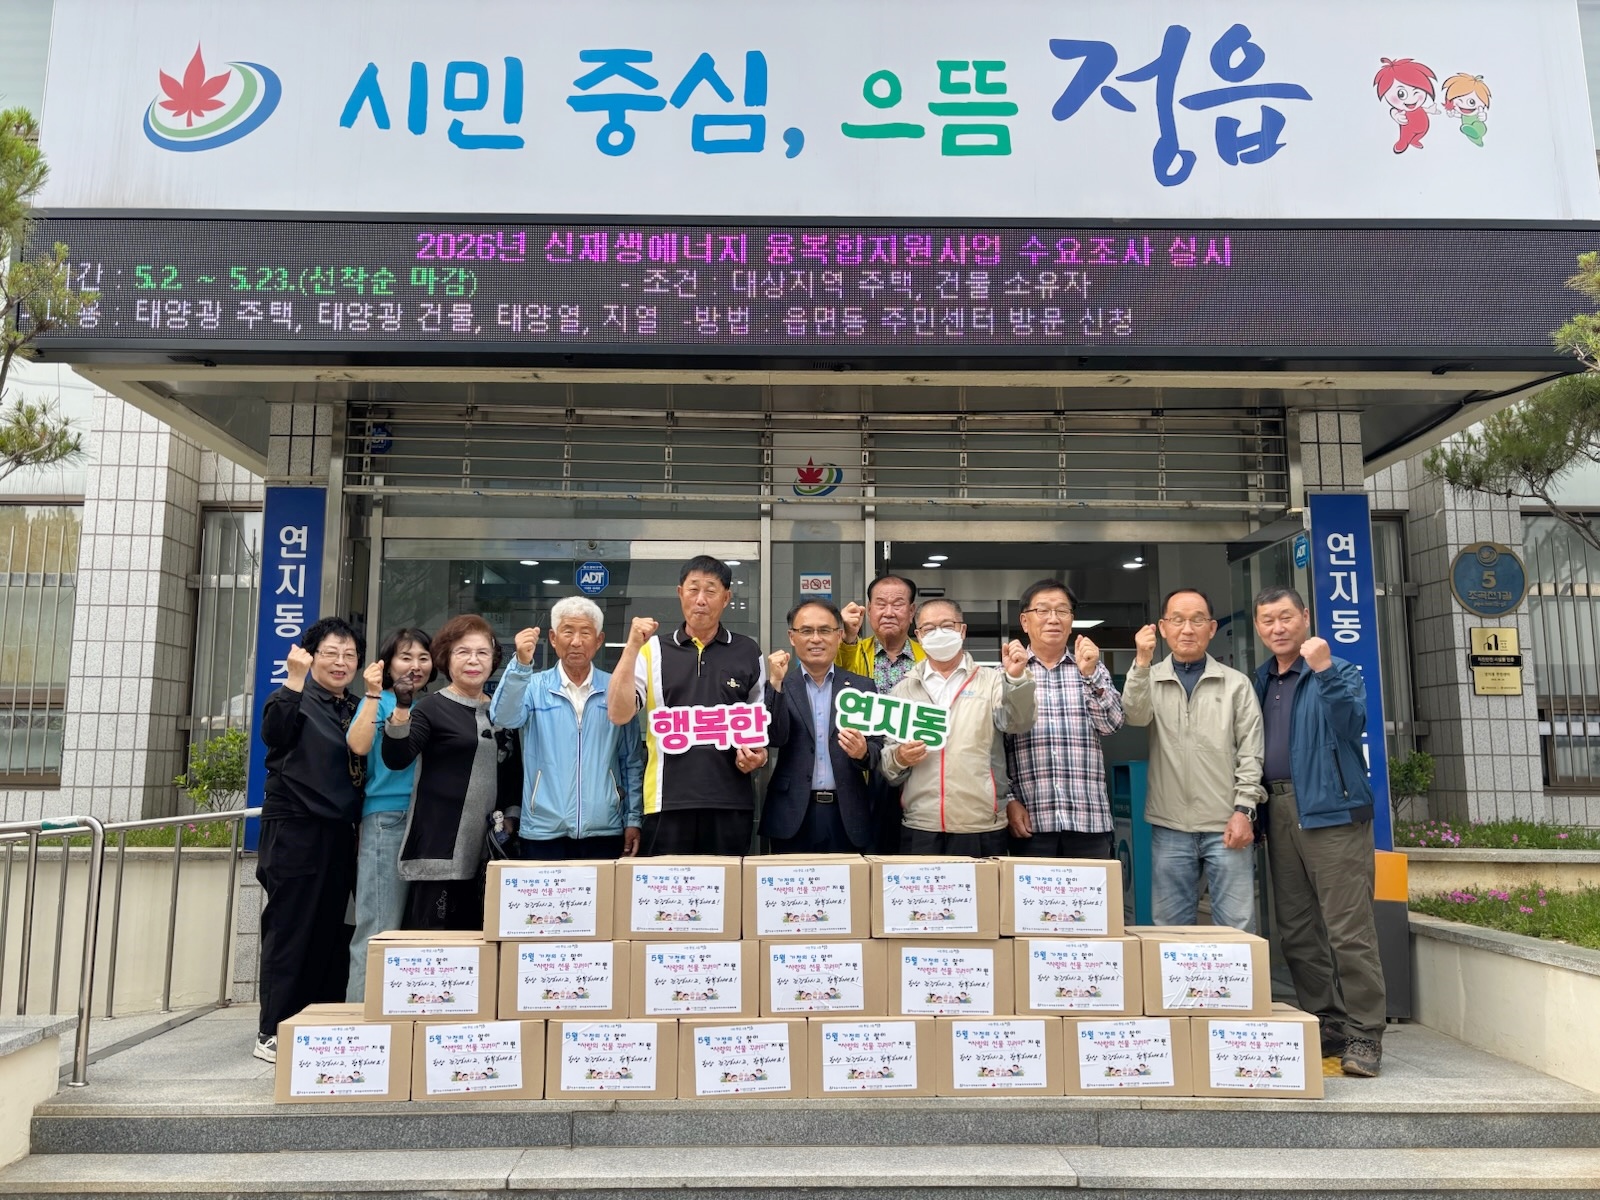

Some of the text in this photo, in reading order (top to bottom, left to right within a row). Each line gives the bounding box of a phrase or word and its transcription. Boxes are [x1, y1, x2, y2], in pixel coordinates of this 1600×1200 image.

[339, 23, 1313, 187] 시민 중심, 으뜸 정읍
[416, 231, 1231, 267] 2026년 신재생에너지 융복합지원사업 수요조사 실시
[411, 267, 477, 297] 마감)
[643, 269, 697, 298] 조건
[733, 270, 843, 299] 대상지역
[859, 271, 922, 301] 주택,
[936, 271, 990, 299] 건물
[1004, 271, 1092, 299] 소유자
[136, 300, 222, 329] 태양광
[236, 301, 301, 332] 주택,
[319, 302, 403, 331] 태양광
[417, 303, 481, 334] 건물,
[498, 303, 589, 335] 태양열,
[602, 304, 657, 334] 지열
[783, 307, 867, 336] 읍면동
[881, 307, 994, 336] 주민센터
[1010, 308, 1065, 336] 방문
[1079, 308, 1132, 336] 신청
[274, 525, 309, 638] 연지동
[580, 572, 604, 584] ADT
[1482, 570, 1496, 589] 5
[1327, 532, 1361, 644] 연지동
[839, 691, 947, 747] 연지동
[653, 706, 768, 750] 행복한
[506, 879, 518, 887] 5월
[762, 877, 774, 886] 5월
[1019, 875, 1031, 884] 5월
[542, 888, 553, 896] 선물
[797, 886, 808, 894] 선물
[1054, 886, 1066, 894] 선물
[522, 953, 534, 962] 5월
[774, 955, 786, 963] 5월
[1034, 951, 1046, 960] 5월
[558, 962, 570, 971] 선물
[809, 964, 821, 972] 선물
[1070, 961, 1081, 970] 선물
[1082, 1031, 1094, 1039] 5월
[297, 1036, 310, 1045] 5월
[699, 1037, 711, 1046] 5월
[1118, 1040, 1130, 1048] 선물
[334, 1046, 346, 1054] 선물
[734, 1045, 746, 1053] 선물
